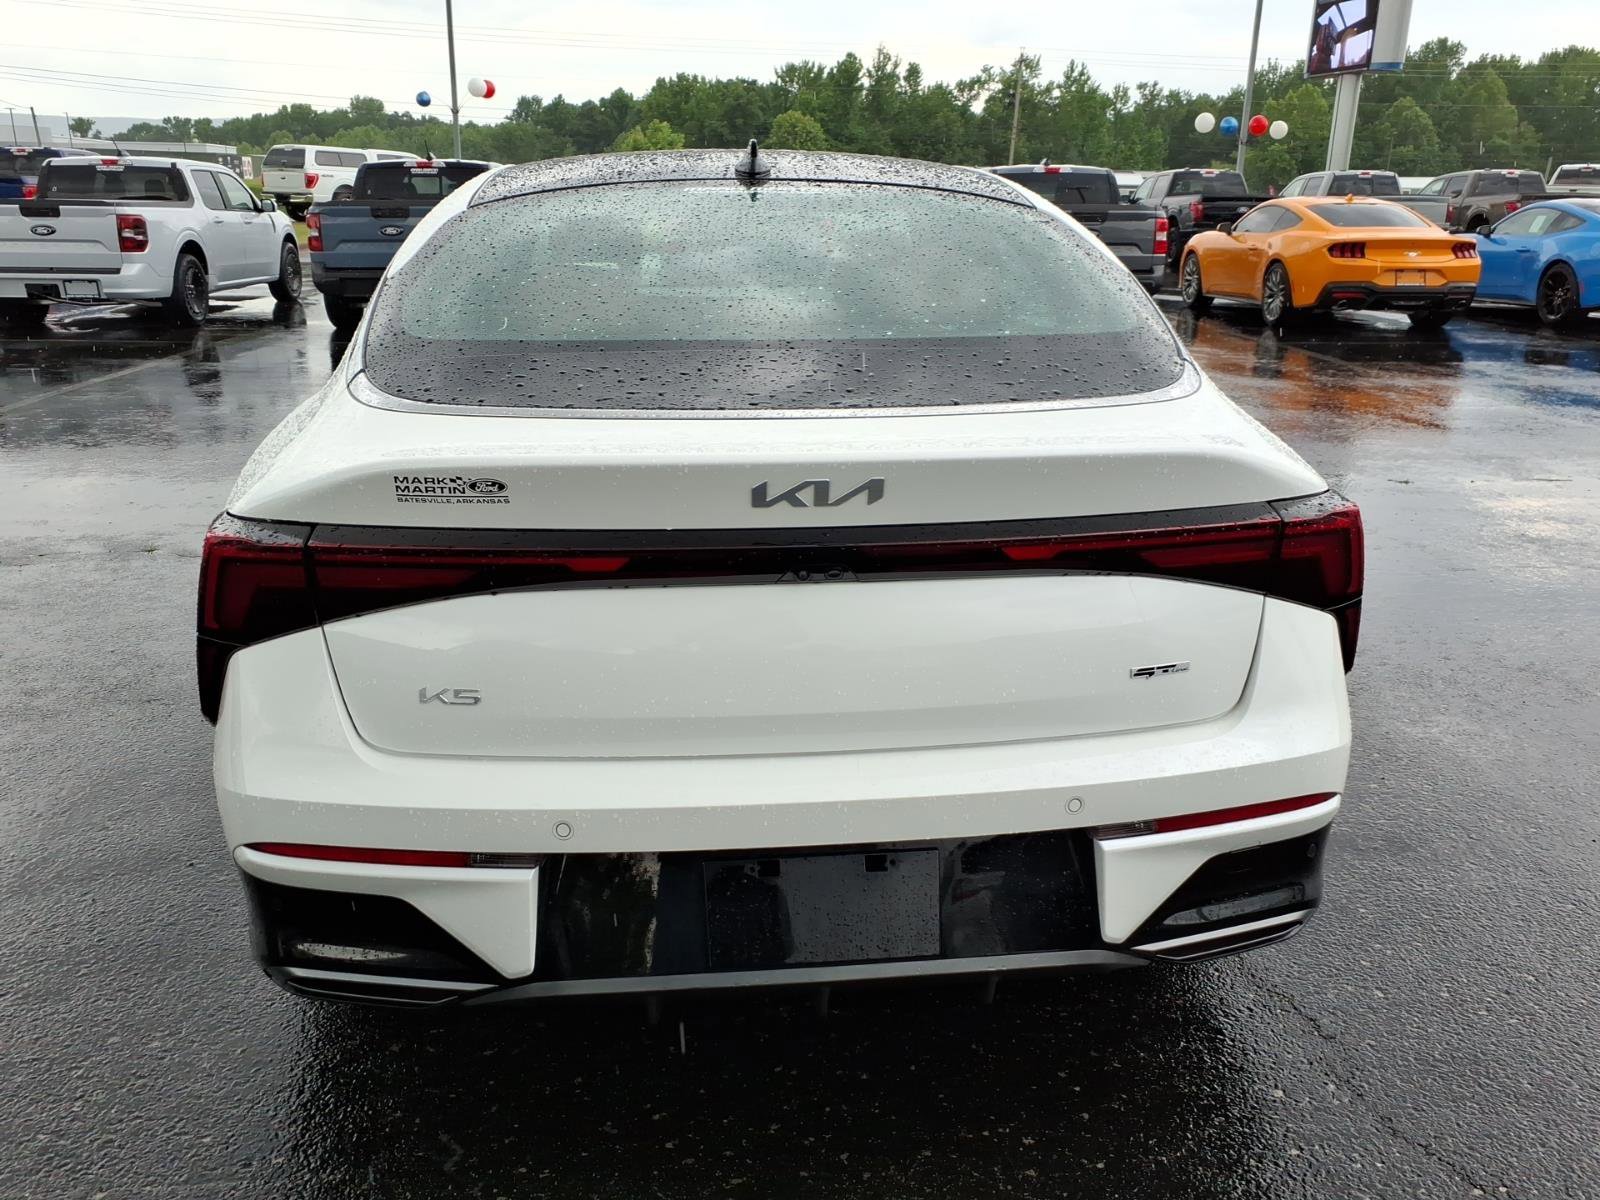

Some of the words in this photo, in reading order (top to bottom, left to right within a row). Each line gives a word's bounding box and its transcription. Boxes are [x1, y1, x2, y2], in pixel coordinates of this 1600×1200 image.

[393, 476, 448, 485] MARK
[395, 485, 466, 494] MARTIN
[474, 481, 500, 492] Ford
[751, 476, 885, 508] KIA
[397, 497, 455, 505] BATESVILLE,
[419, 688, 481, 705] K5
